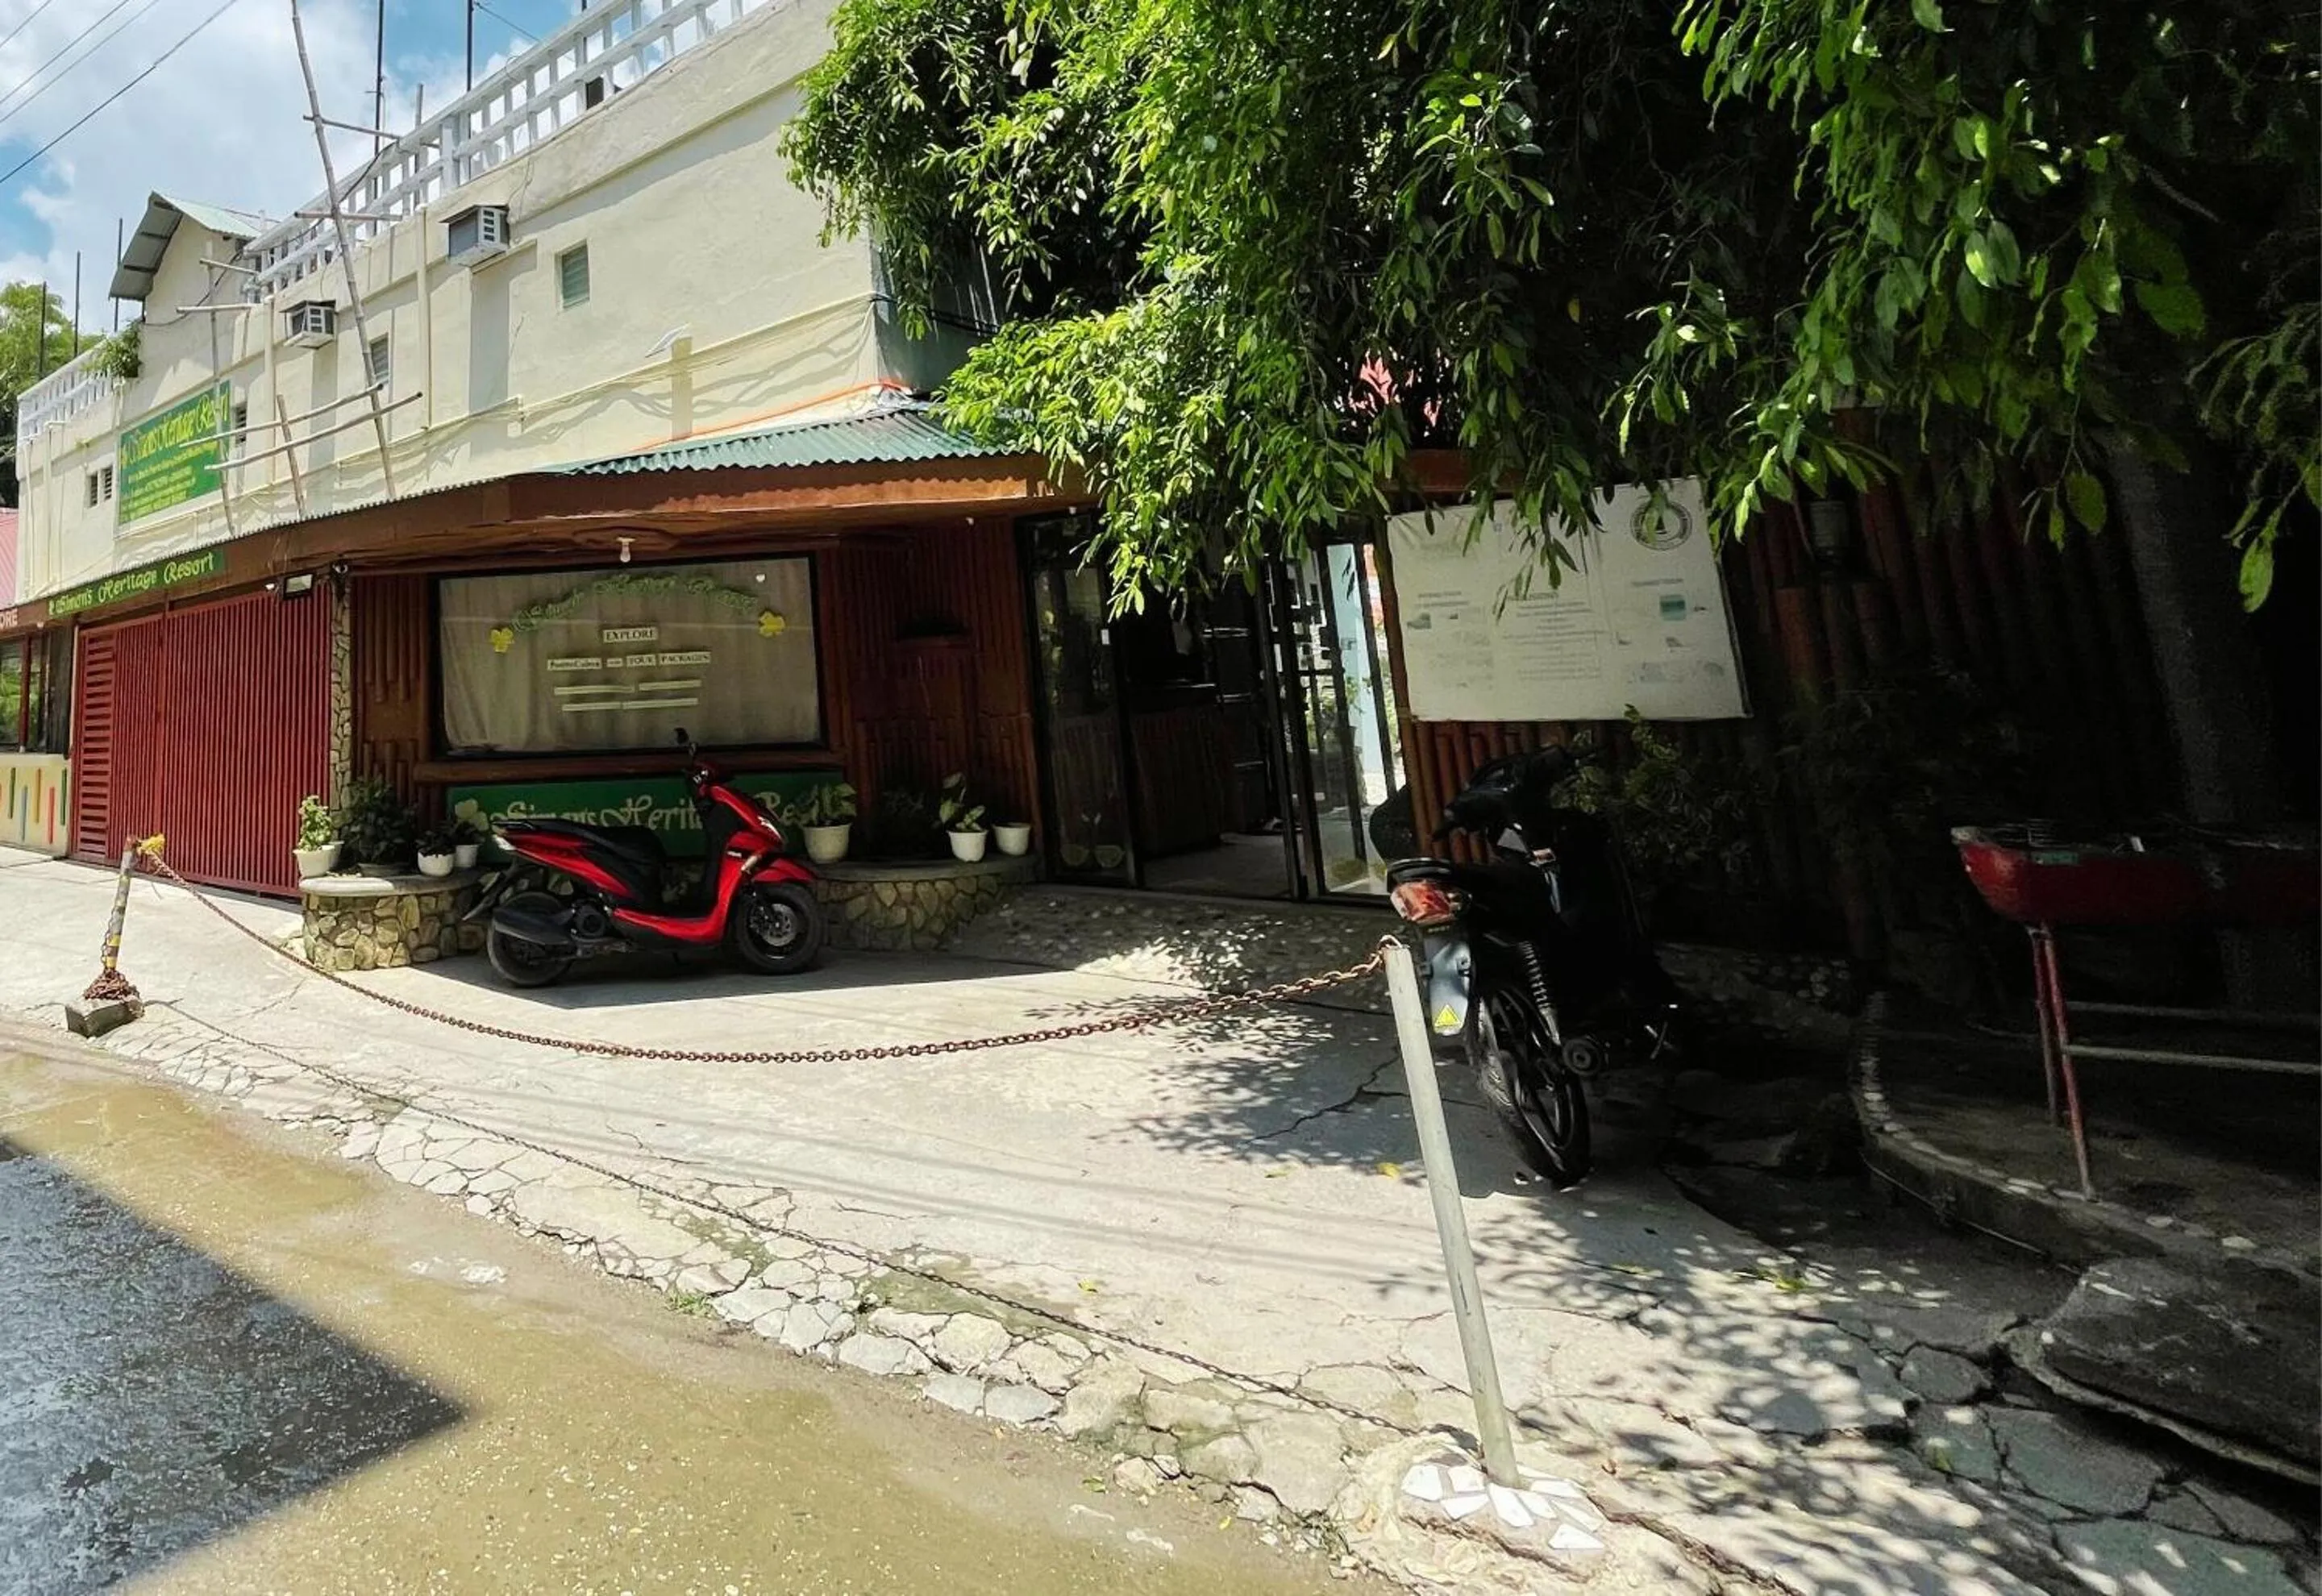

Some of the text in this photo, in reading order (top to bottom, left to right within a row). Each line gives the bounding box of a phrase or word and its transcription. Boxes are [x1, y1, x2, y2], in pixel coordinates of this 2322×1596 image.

[98, 570, 157, 603] Heritage
[164, 551, 214, 584] Resort
[605, 630, 654, 641] EXPLORE
[601, 795, 703, 831] Herit
